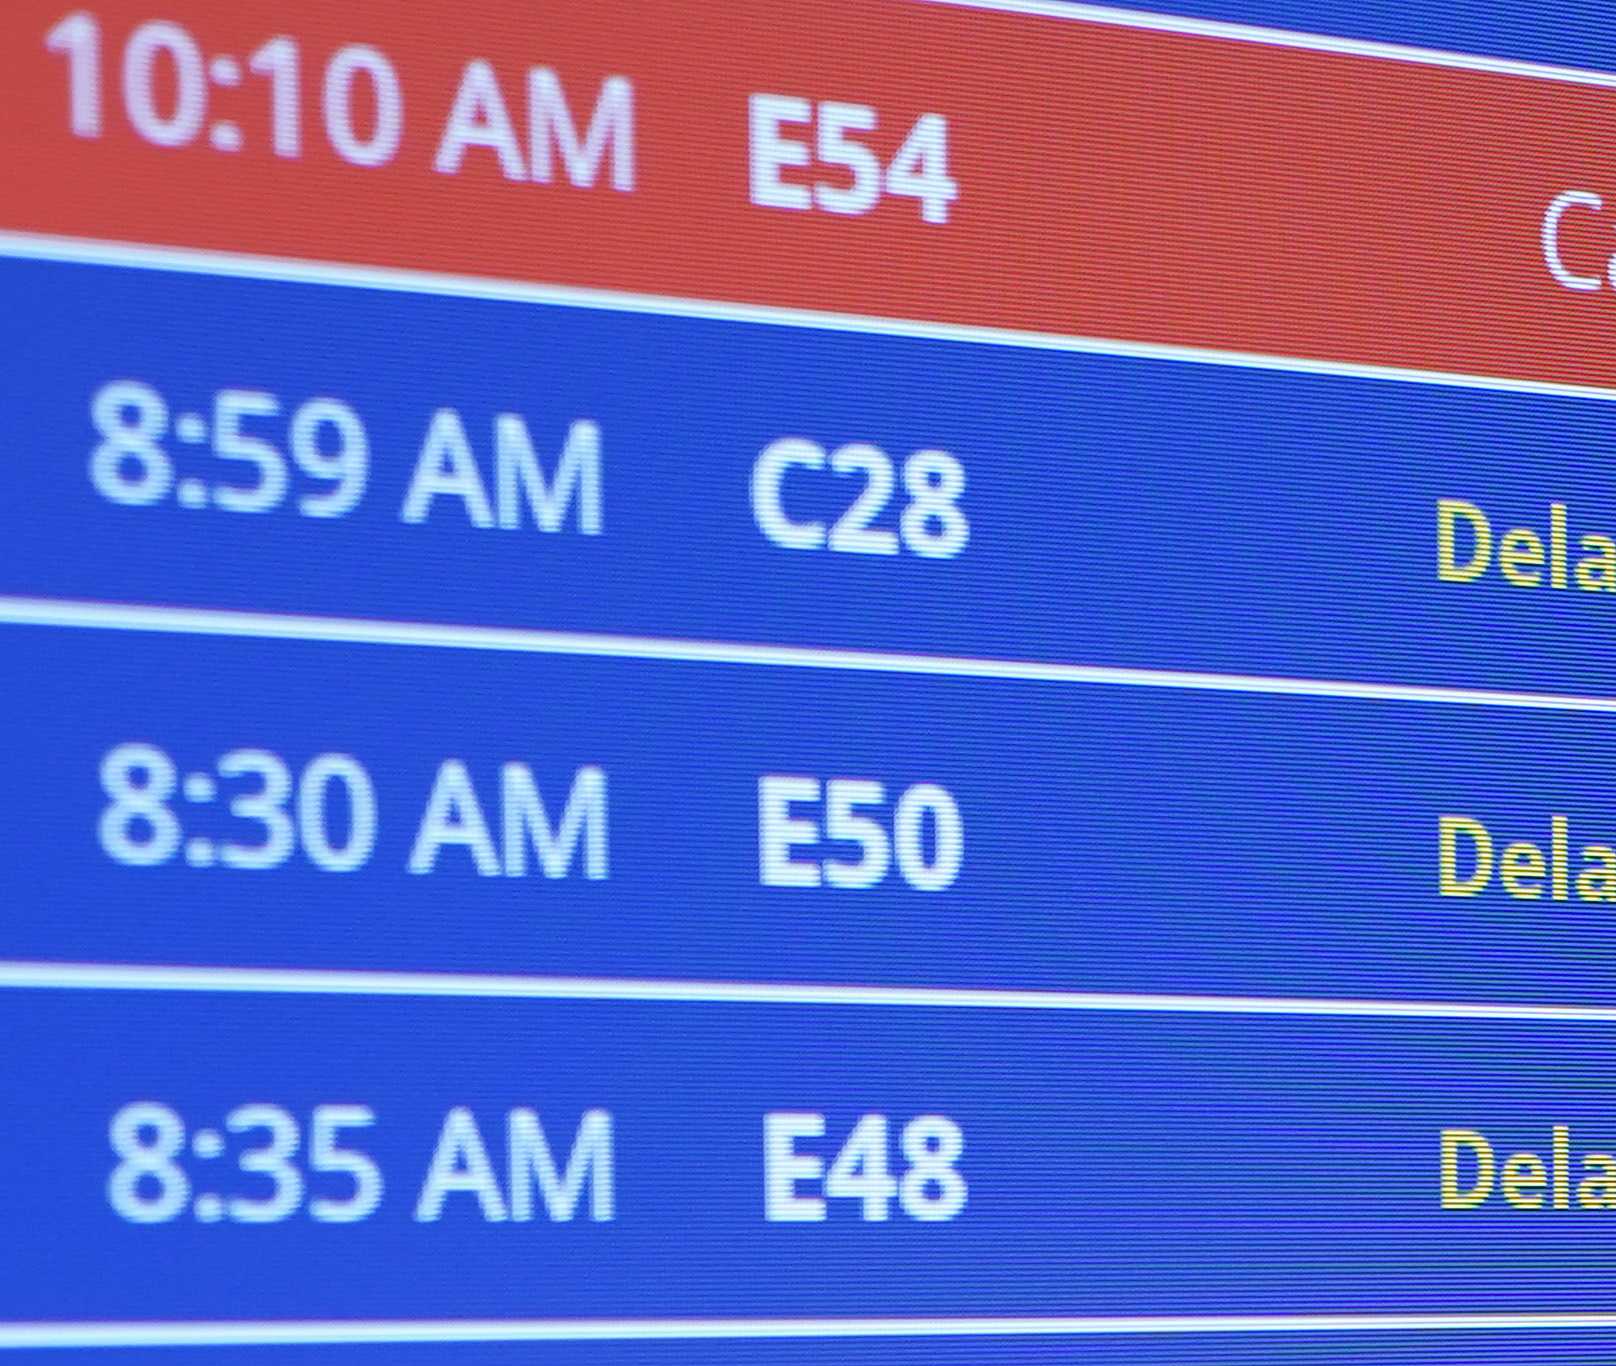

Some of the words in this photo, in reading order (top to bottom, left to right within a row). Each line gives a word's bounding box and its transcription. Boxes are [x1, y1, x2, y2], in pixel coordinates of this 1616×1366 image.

[50, 15, 401, 165] 10:10
[436, 61, 633, 190] AM
[750, 93, 957, 223] E54
[91, 382, 368, 518] 8:59
[402, 410, 601, 535] AM
[751, 438, 969, 559] C28
[99, 745, 376, 872] 8:30
[409, 761, 607, 880] AM
[759, 776, 963, 892] E50
[108, 1103, 382, 1224] 8:35
[416, 1108, 614, 1222] AM
[764, 1113, 967, 1223] E48
